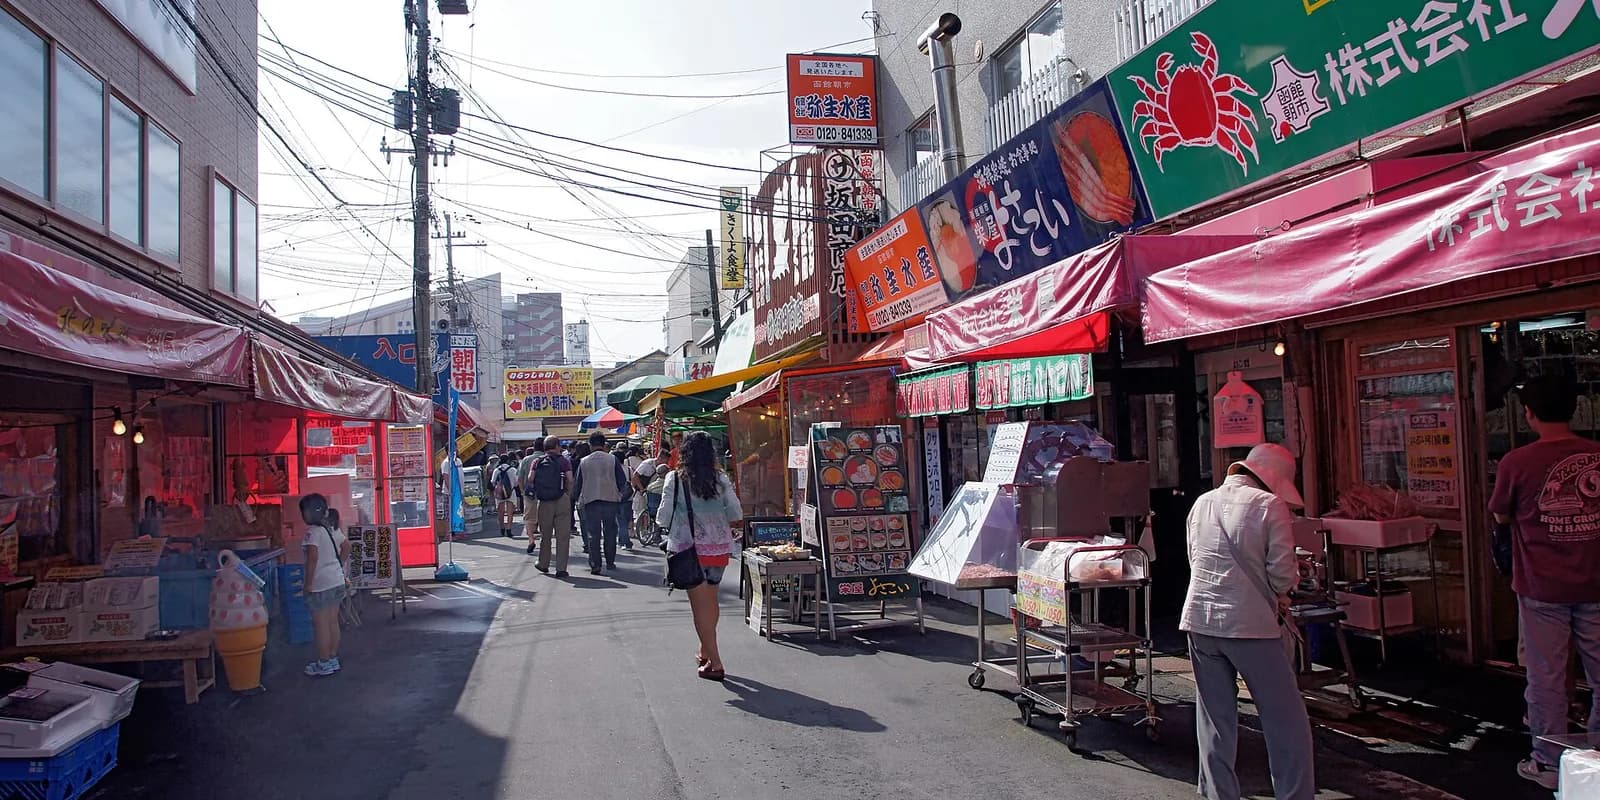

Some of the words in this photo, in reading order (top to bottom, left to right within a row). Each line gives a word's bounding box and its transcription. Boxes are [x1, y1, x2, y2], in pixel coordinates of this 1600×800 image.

[1276, 79, 1306, 105] 函館
[806, 94, 872, 121] 弥生水産
[1283, 101, 1311, 123] 朝市
[451, 347, 475, 392] 朝市
[1540, 514, 1572, 525] HOME
[1549, 524, 1563, 533] IN
